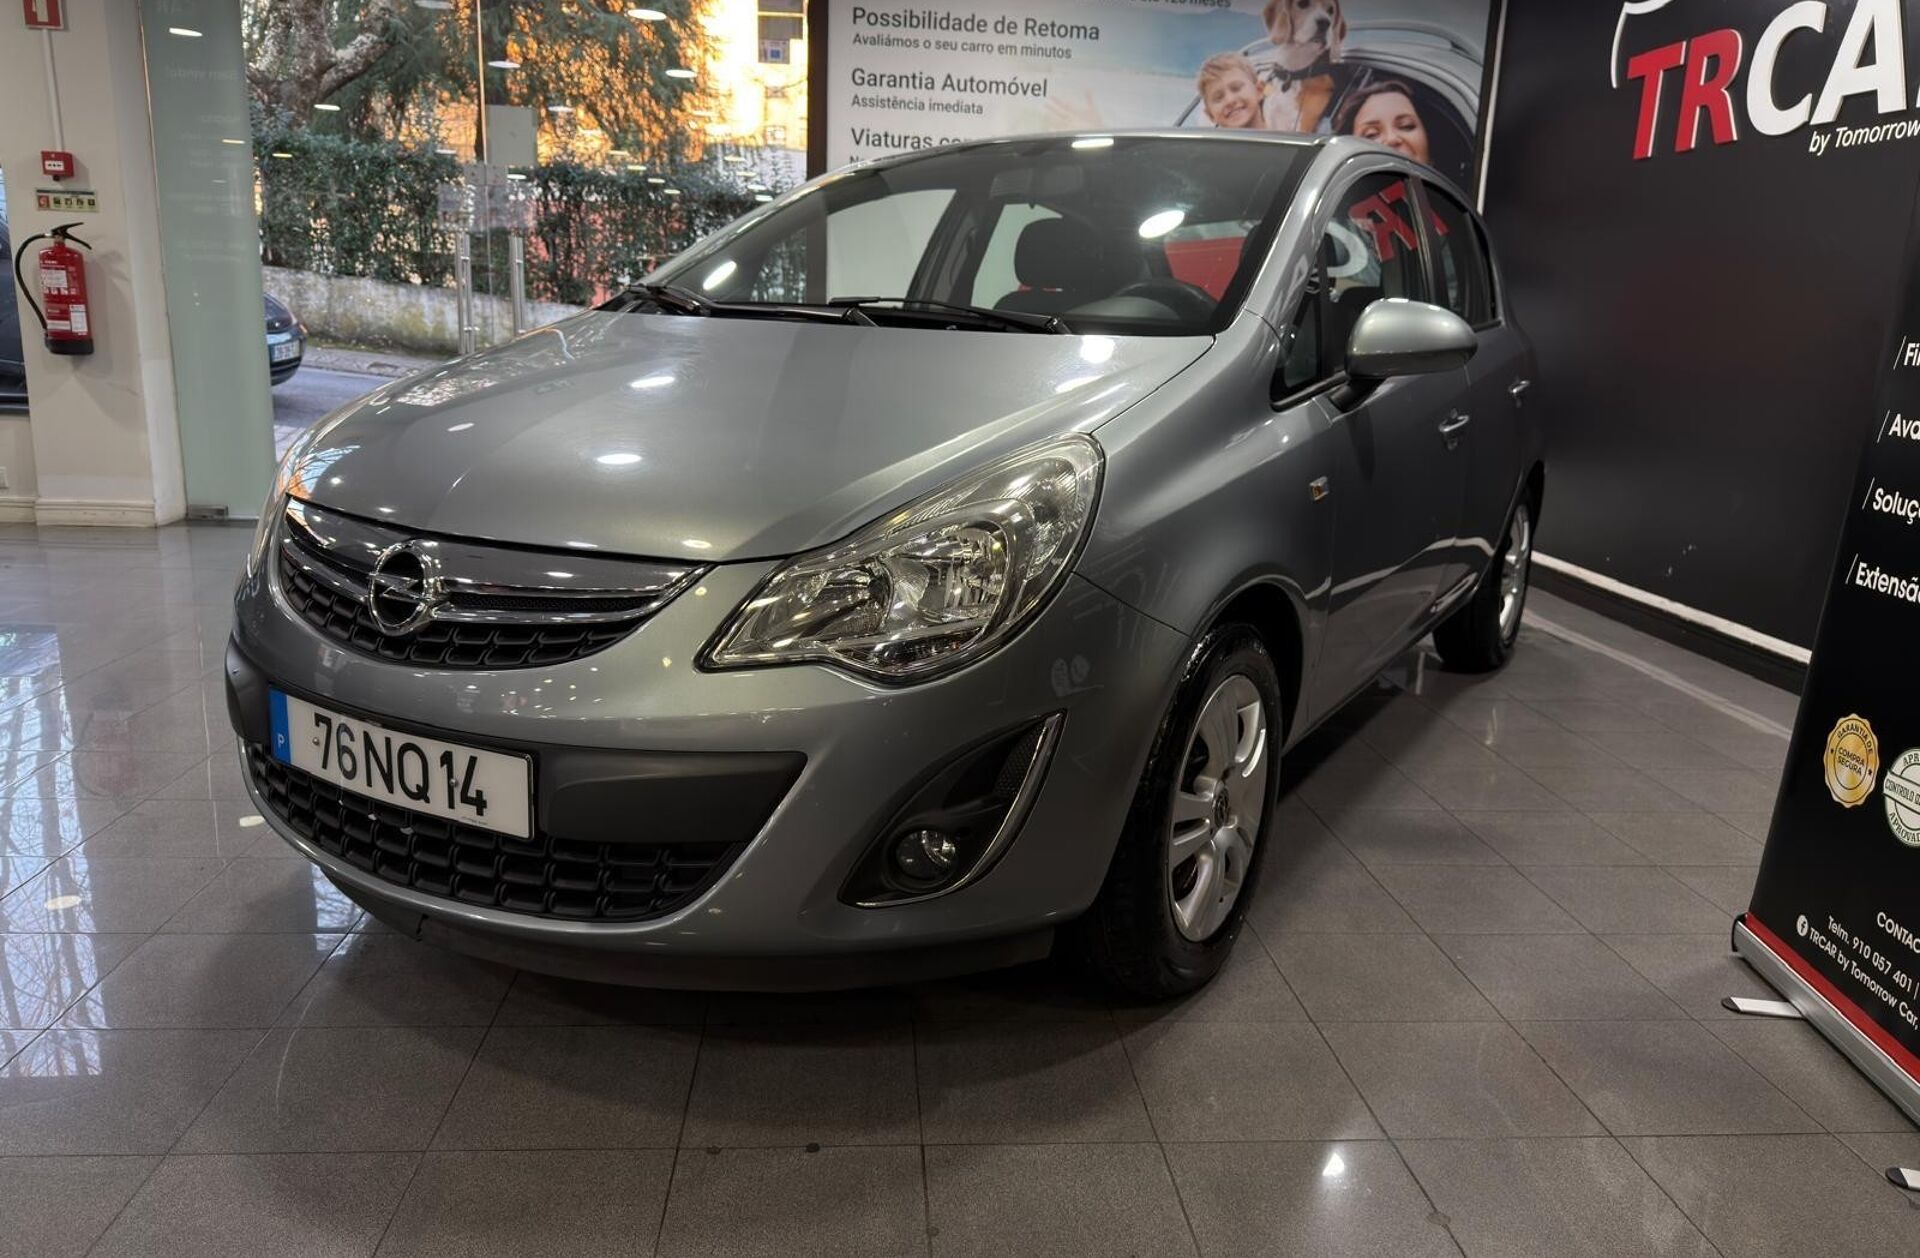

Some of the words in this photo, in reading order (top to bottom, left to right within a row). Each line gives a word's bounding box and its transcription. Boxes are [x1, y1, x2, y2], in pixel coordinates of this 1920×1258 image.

[852, 7, 988, 33] Possibilidade
[994, 15, 1018, 36] de
[1024, 18, 1100, 40] Retoma
[852, 33, 920, 49] Avaliámos
[923, 40, 932, 49] o
[935, 40, 959, 52] seu
[961, 41, 994, 54] carro
[997, 44, 1018, 56] em
[1020, 43, 1072, 59] minutos
[852, 68, 935, 91] Garantia
[942, 73, 1048, 97] Automóvel
[1626, 0, 1920, 160] TRCA
[851, 94, 925, 111] Assistência
[928, 99, 984, 115] imediata
[851, 127, 933, 150] Viaturas
[1808, 130, 1830, 157] by
[1834, 119, 1920, 149] Tomorrow
[1872, 487, 1920, 525] Soluç
[1855, 561, 1920, 603] Extensã
[277, 733, 285, 746] P
[1838, 746, 1865, 766] COMPRA
[1828, 915, 1850, 944] Telm.
[1852, 936, 1871, 959] 910
[1872, 952, 1892, 975] 057
[1892, 970, 1913, 993] 401
[1809, 927, 1838, 959] TRCAR
[1837, 950, 1850, 972] by
[1851, 961, 1898, 1008] Tomorrow
[1898, 1001, 1918, 1031] Car,
